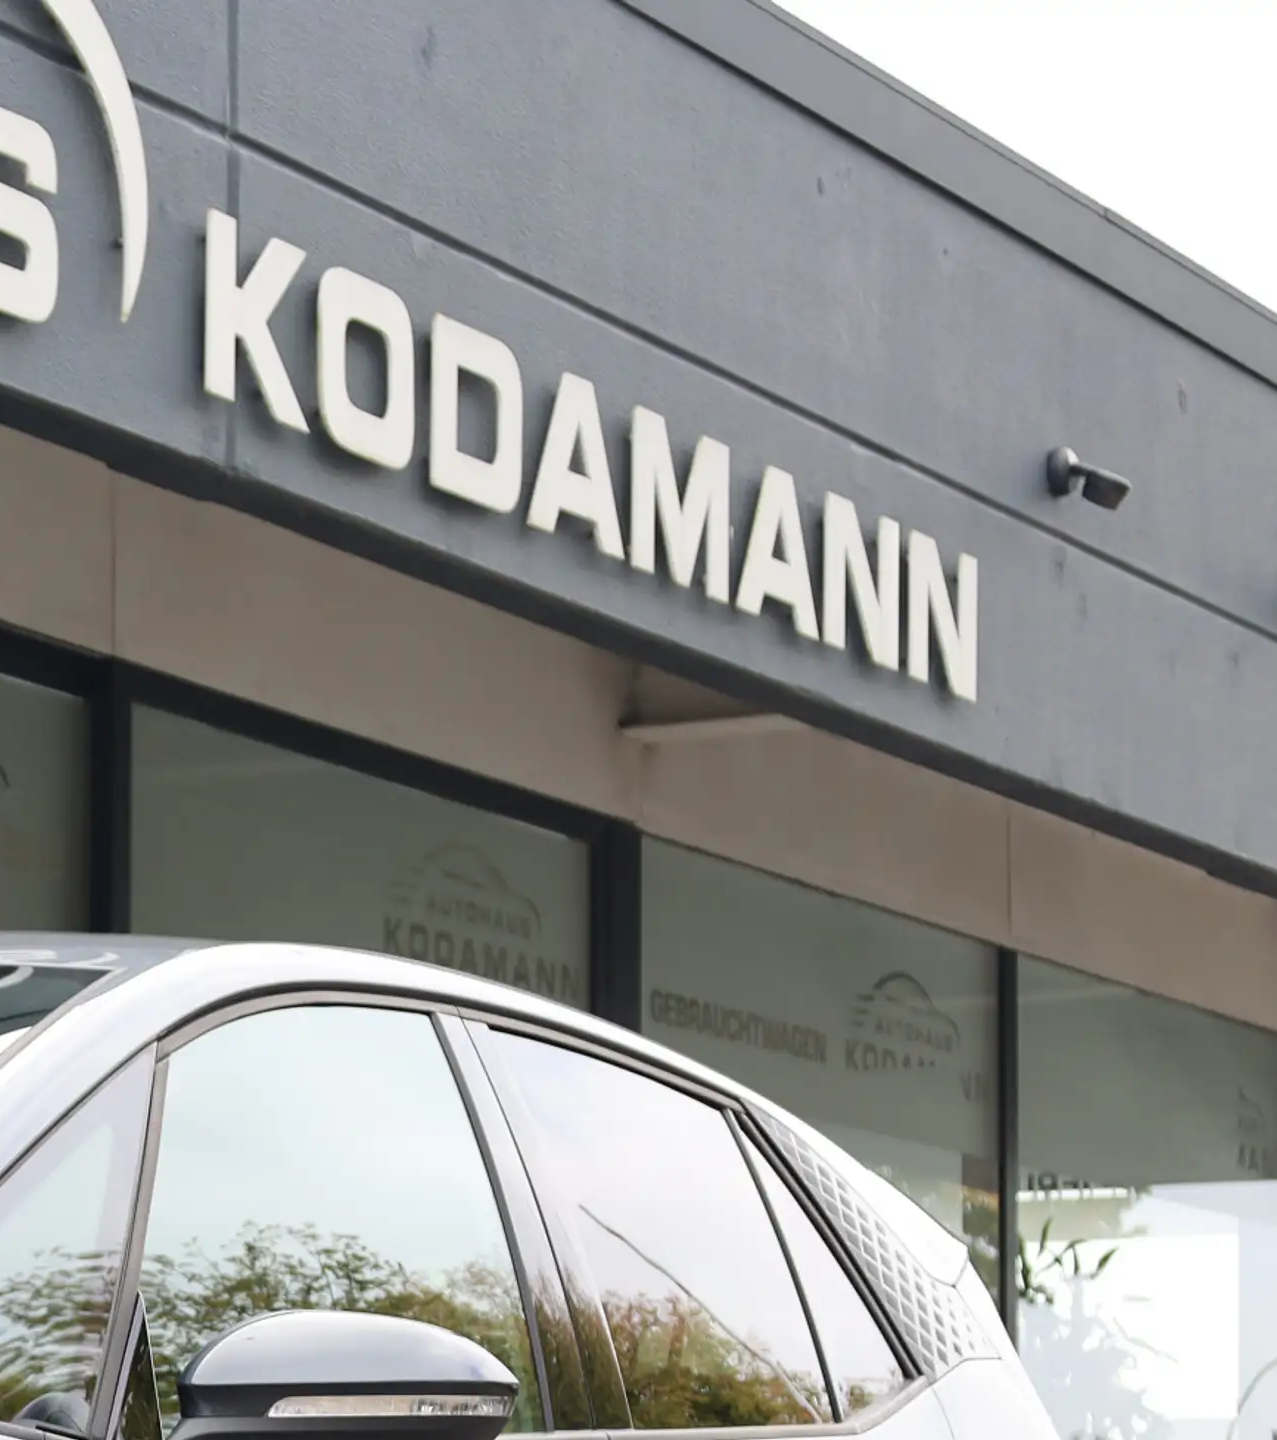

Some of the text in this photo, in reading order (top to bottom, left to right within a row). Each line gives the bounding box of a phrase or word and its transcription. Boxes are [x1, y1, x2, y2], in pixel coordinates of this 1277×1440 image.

[202, 208, 980, 704] KODAMANN
[382, 915, 581, 999] KODAMANN
[649, 987, 828, 1064] GEBRAUCHTWAGEN
